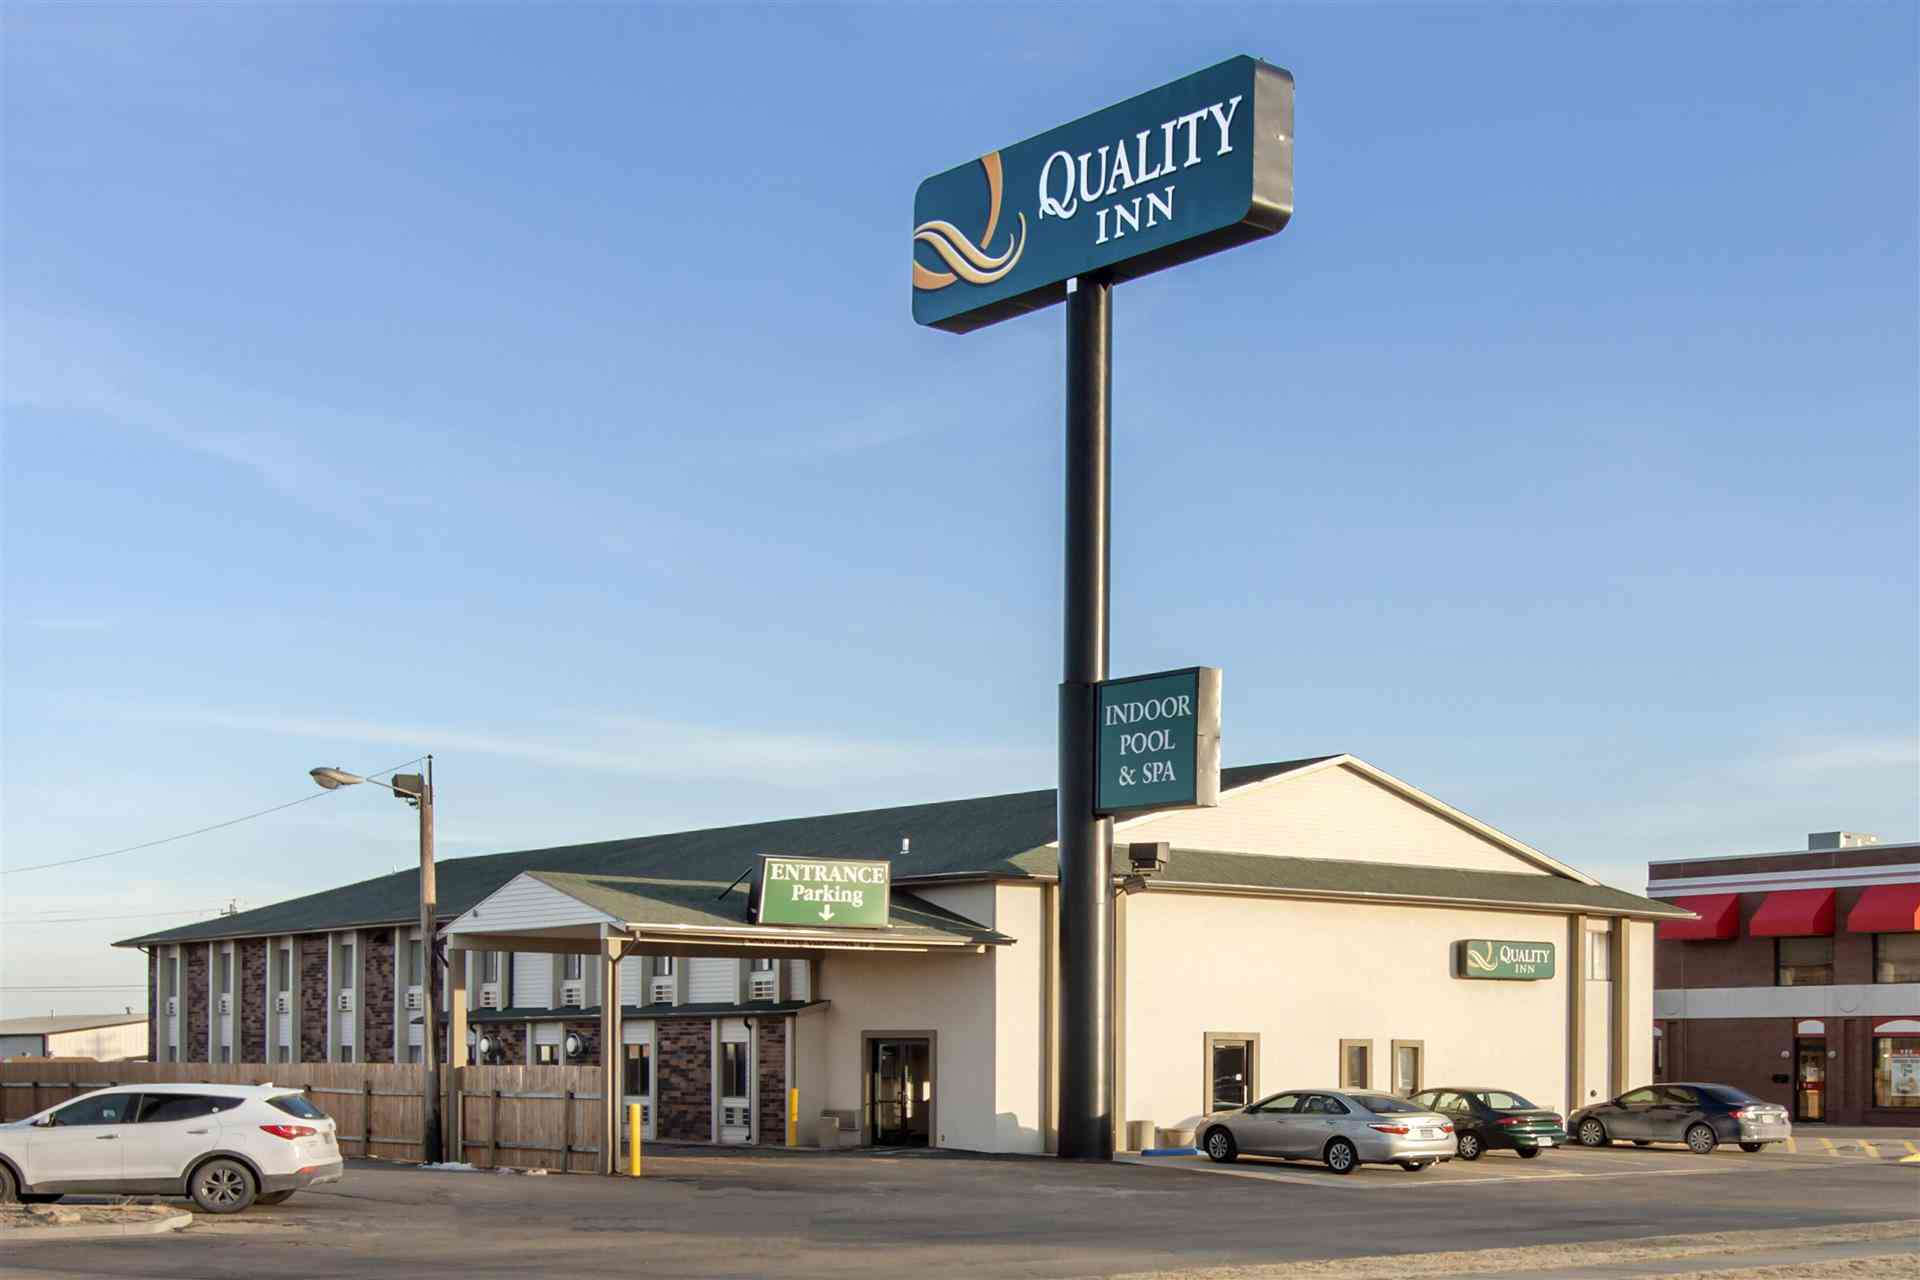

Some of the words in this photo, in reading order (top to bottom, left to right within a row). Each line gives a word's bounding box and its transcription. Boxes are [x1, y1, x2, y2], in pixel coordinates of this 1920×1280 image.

[1039, 95, 1242, 219] QUALITY
[1096, 186, 1175, 244] INN
[1105, 695, 1191, 726] INDOOR
[1120, 729, 1175, 755] POOL
[1119, 766, 1136, 785] &
[1142, 760, 1176, 783] SPA
[770, 863, 884, 884] ENTRANCE
[792, 884, 864, 907] Parking
[1500, 945, 1550, 963] QUALITY
[1515, 964, 1535, 974] INN
